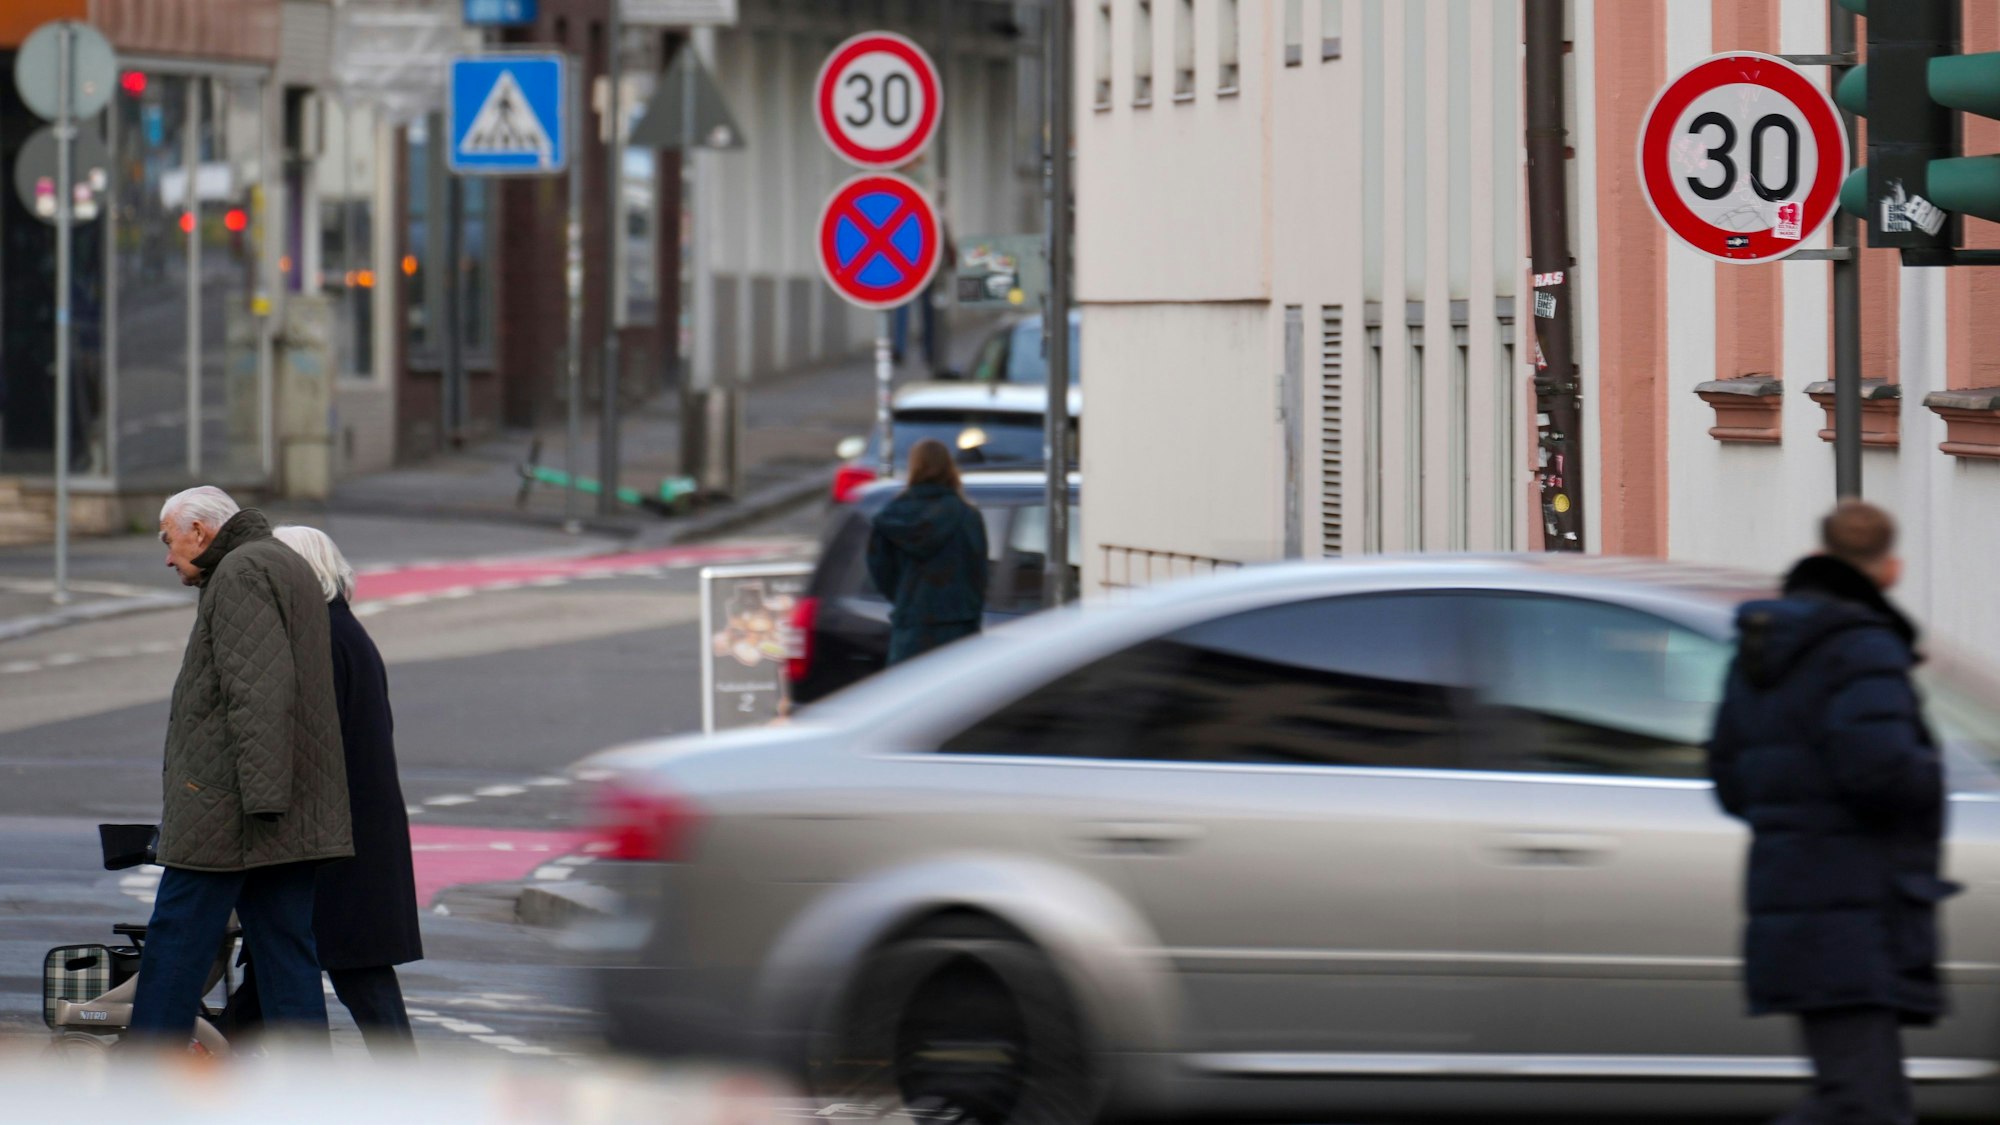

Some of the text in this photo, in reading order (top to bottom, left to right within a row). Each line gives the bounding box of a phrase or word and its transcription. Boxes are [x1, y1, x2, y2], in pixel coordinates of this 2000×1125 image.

[845, 72, 911, 129] 30
[1687, 111, 1801, 202] 30
[1537, 301, 1554, 310] EINS
[1536, 308, 1553, 318] NULL
[80, 1010, 107, 1021] NITRO
